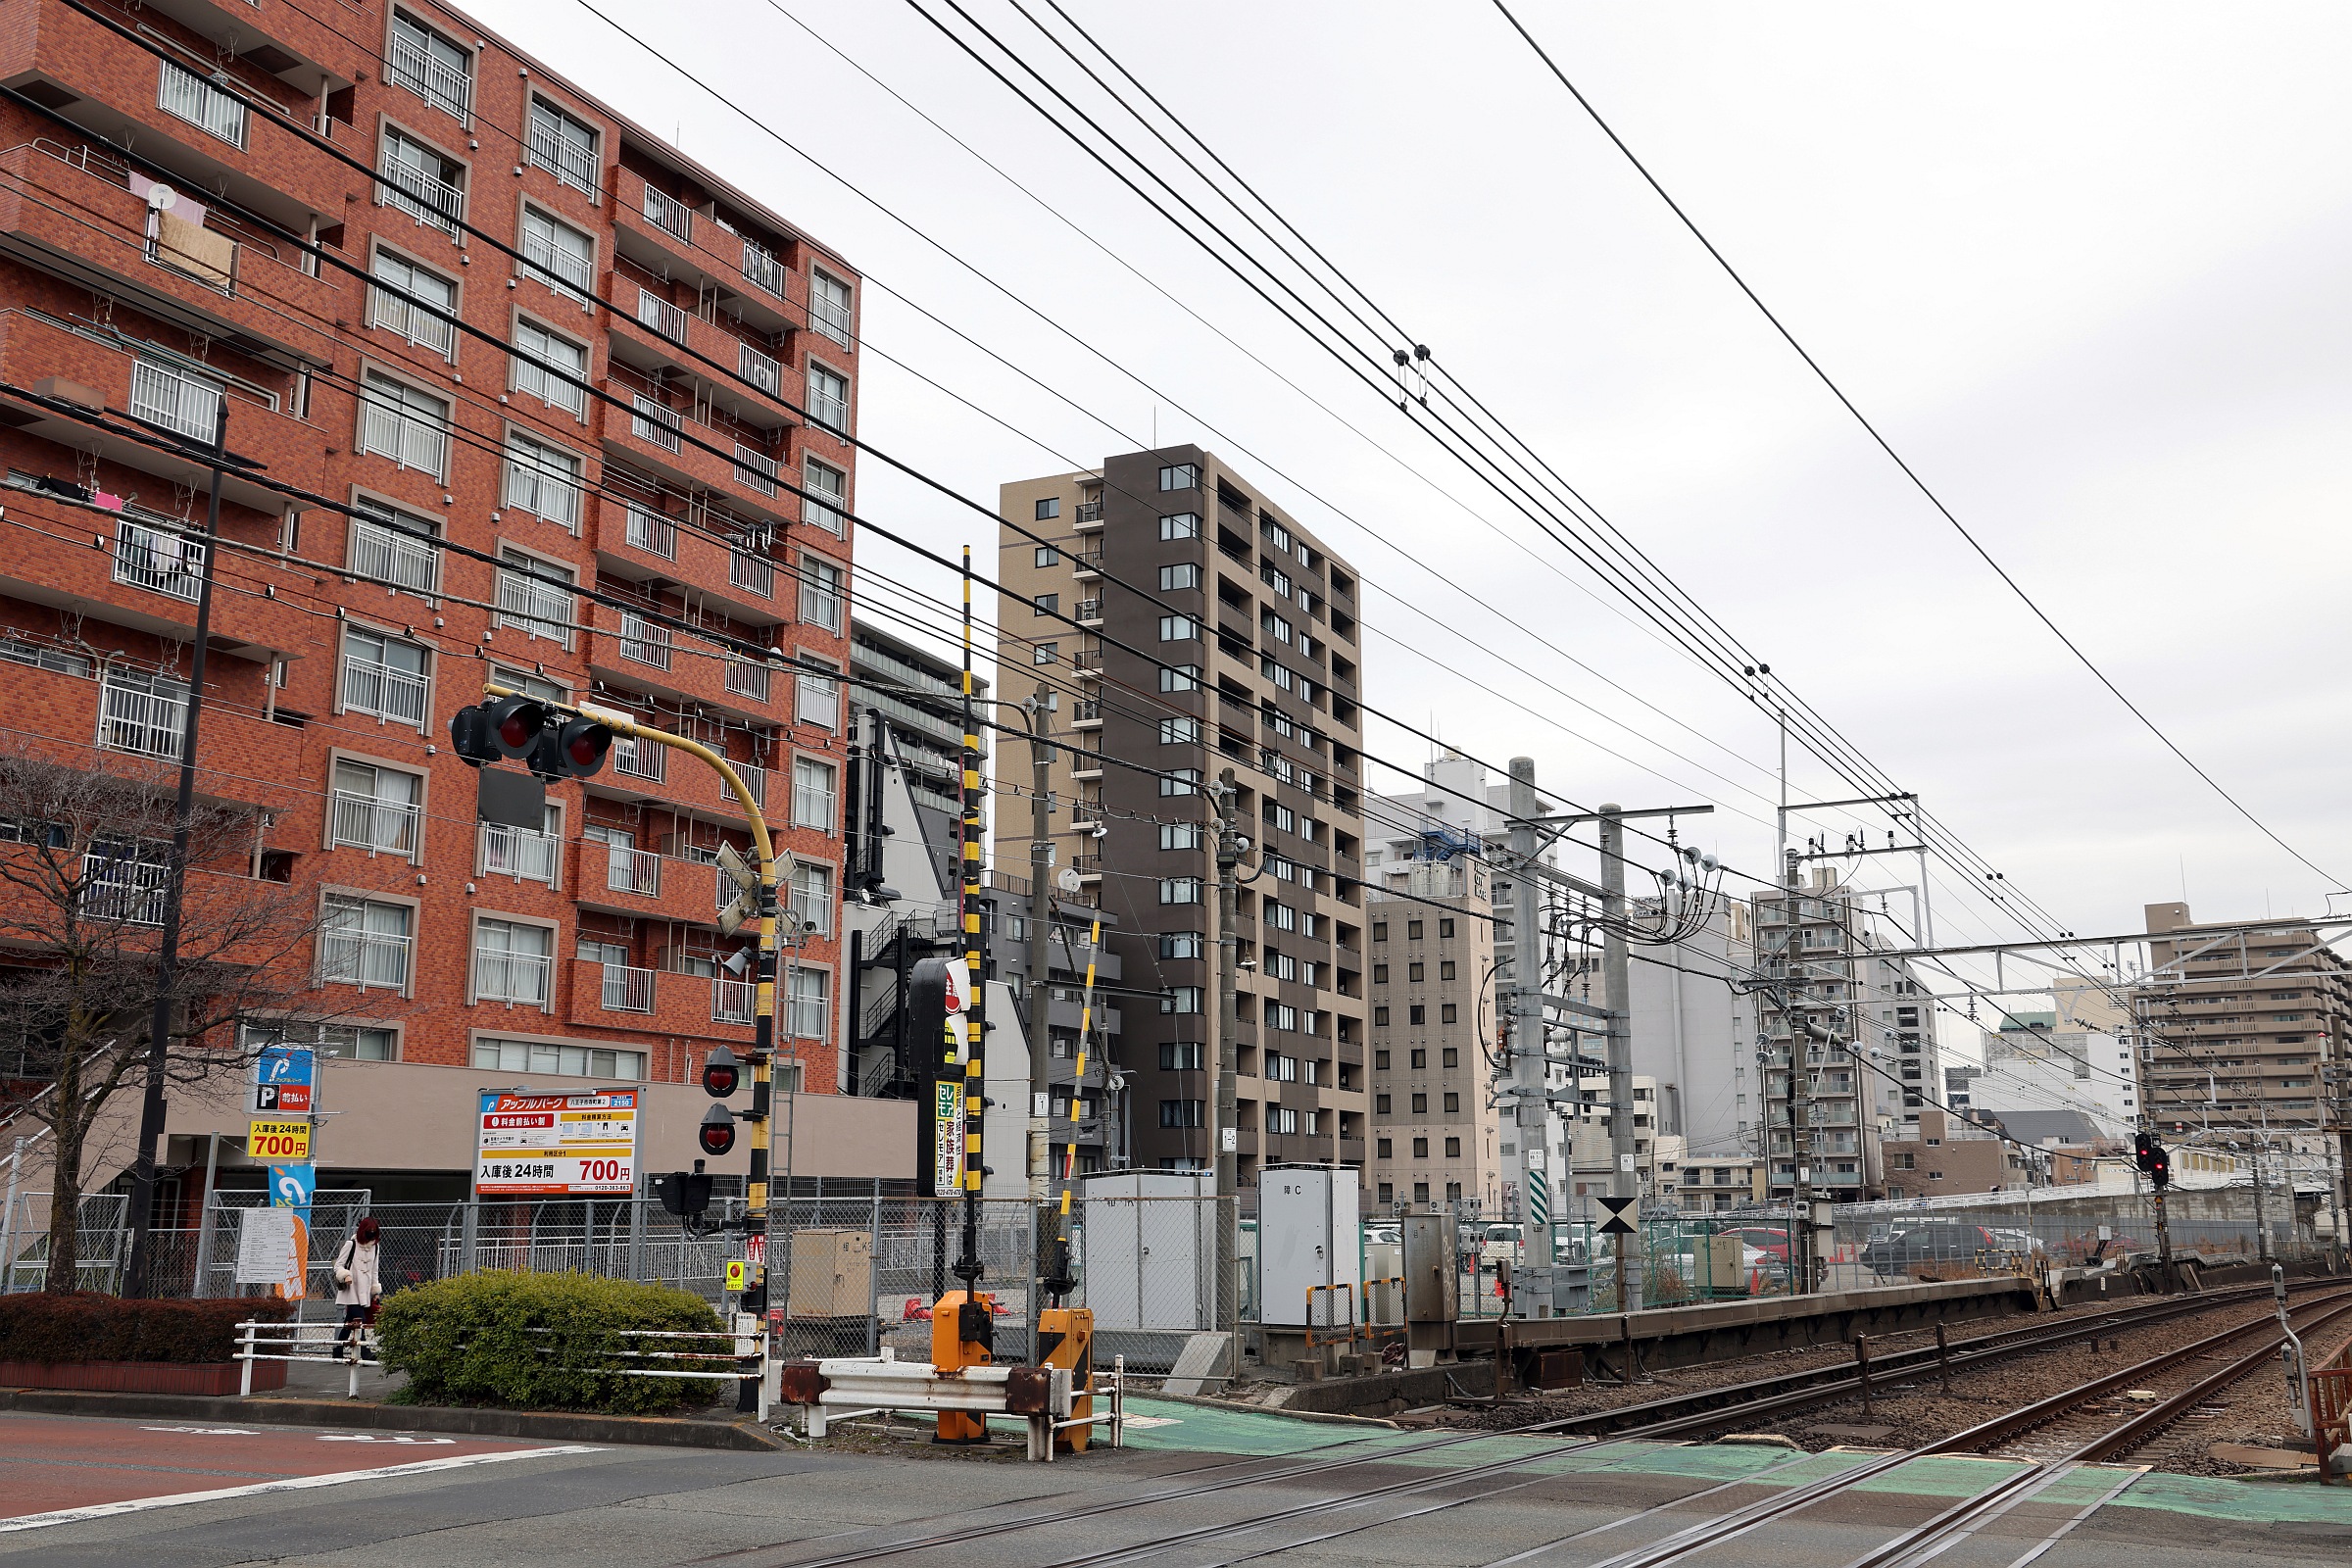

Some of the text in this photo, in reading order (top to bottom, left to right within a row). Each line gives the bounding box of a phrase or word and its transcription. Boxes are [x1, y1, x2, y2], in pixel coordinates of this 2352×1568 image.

[261, 1087, 275, 1107] P
[282, 1093, 308, 1103] 前払い
[500, 1098, 564, 1110] アップルパーク
[254, 1136, 307, 1155] 700円
[946, 1121, 955, 1185] 家族葬は
[579, 1159, 630, 1181] 700円
